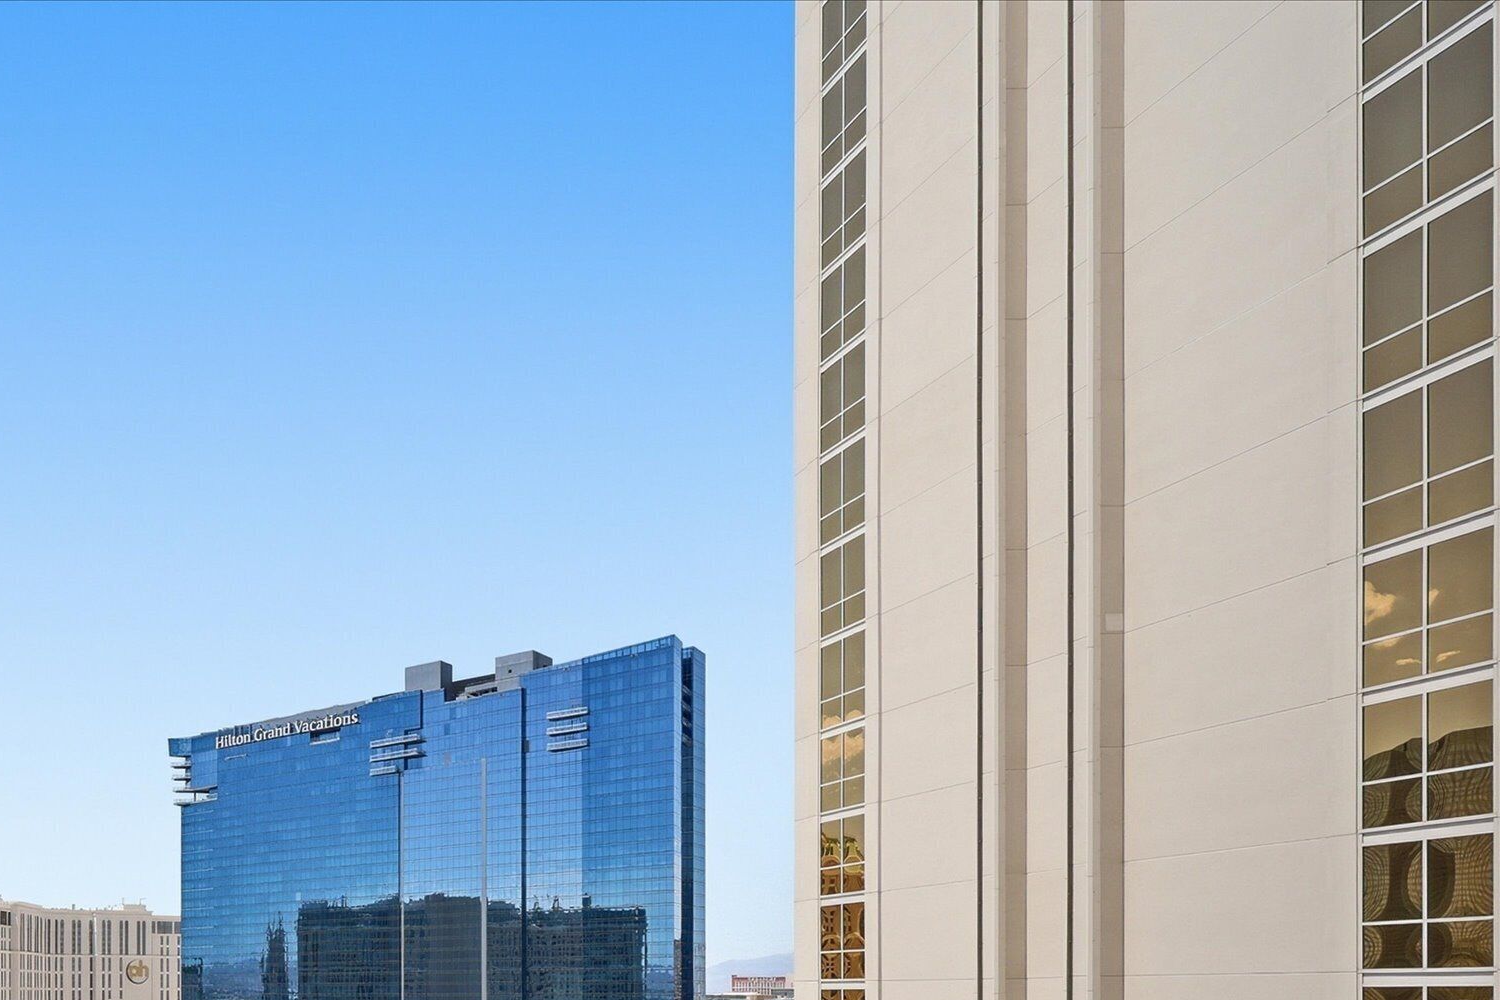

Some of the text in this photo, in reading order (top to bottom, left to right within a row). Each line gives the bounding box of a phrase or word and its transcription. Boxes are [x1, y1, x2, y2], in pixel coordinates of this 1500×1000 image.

[215, 713, 359, 749] Hilton Grand Vacations
